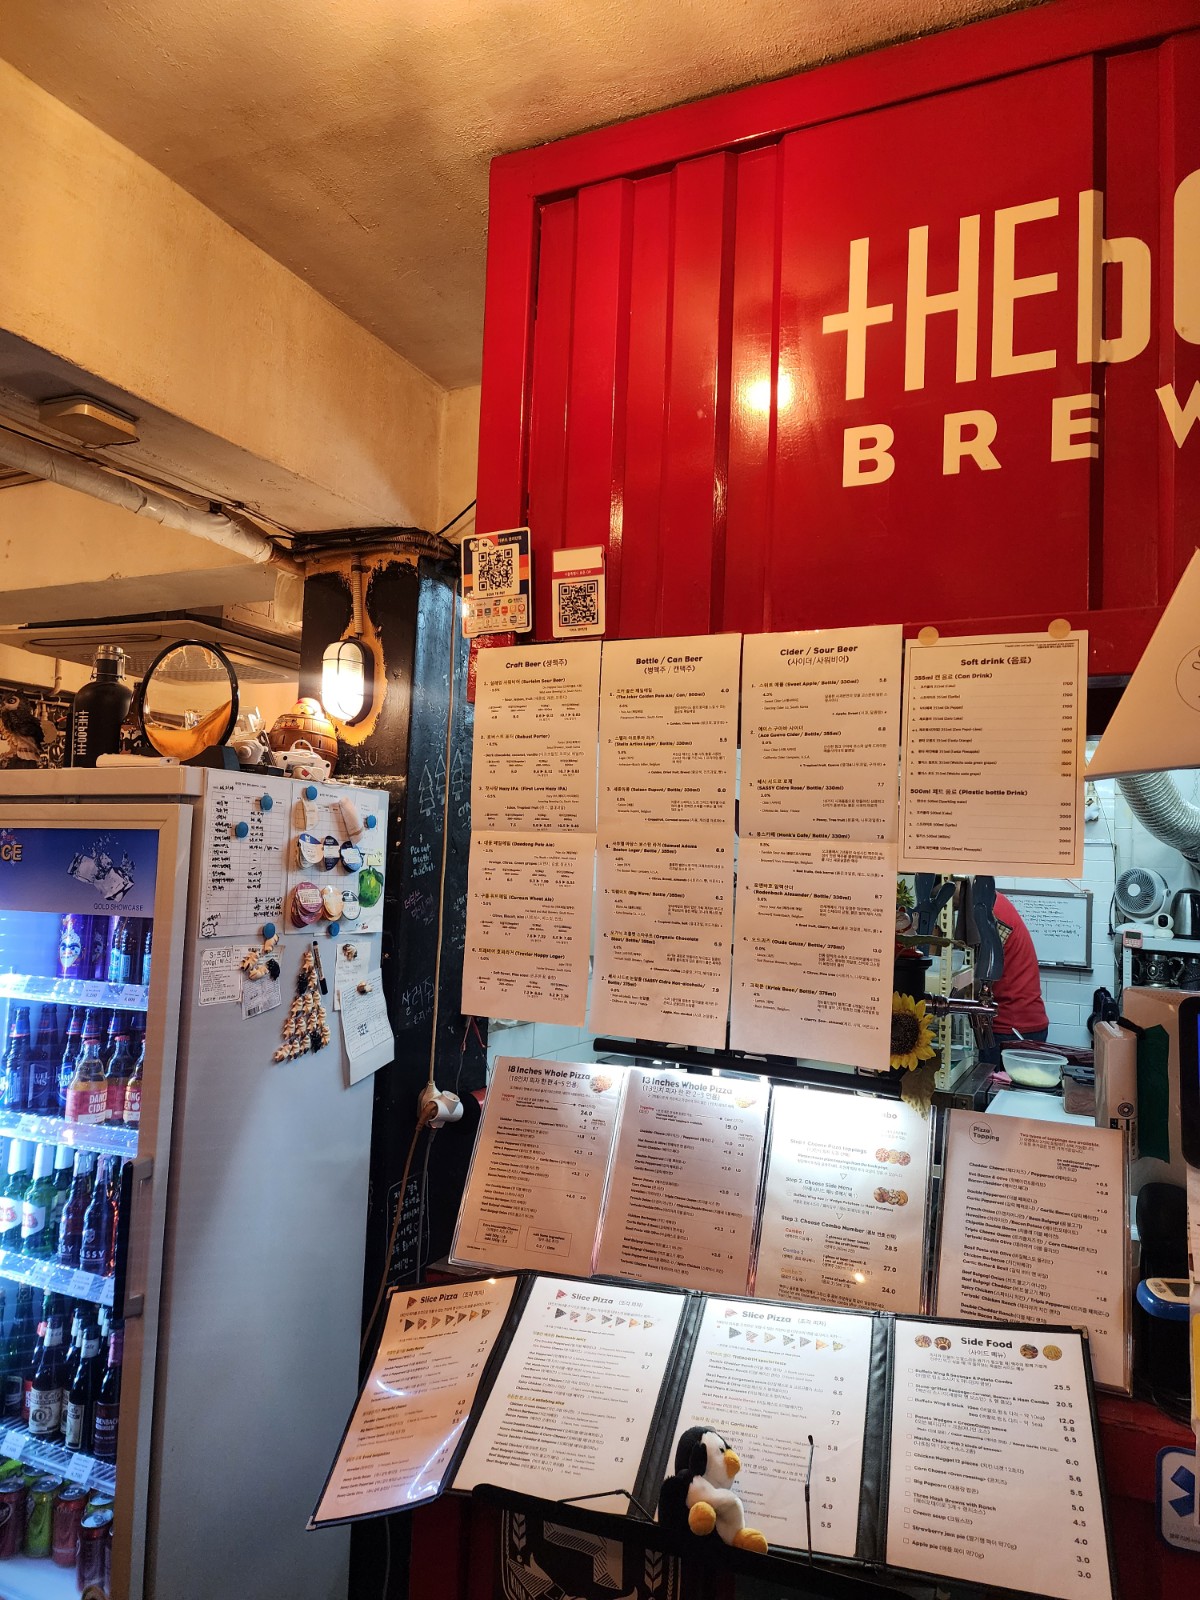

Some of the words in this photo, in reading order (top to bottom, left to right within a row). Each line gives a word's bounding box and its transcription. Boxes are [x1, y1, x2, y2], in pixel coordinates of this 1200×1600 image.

[780, 648, 804, 656] Cider
[981, 657, 1004, 665] drink
[516, 1066, 542, 1075] Inches
[544, 1069, 568, 1078] Whole
[570, 1072, 590, 1080] Pizza
[642, 1076, 651, 1084] 13
[652, 1078, 680, 1088] Inches
[681, 1080, 708, 1092] Whole
[710, 1084, 732, 1094] Pizza
[973, 1133, 1000, 1142] Topping
[800, 1219, 820, 1227] Choose
[822, 1222, 841, 1230] Combo
[884, 1244, 898, 1252] 28.5
[883, 1265, 896, 1273] 27.0
[882, 1287, 896, 1295] 24.0
[439, 1293, 458, 1301] Pizza
[571, 1293, 591, 1301] Slice
[743, 1311, 764, 1320] Slice
[766, 1314, 792, 1323] Pizza
[961, 1337, 984, 1346] Side
[986, 1340, 1013, 1349] Food
[1070, 1489, 1083, 1497] 5.5
[1071, 1504, 1085, 1512] 5.0
[1073, 1519, 1086, 1527] 4.5
[912, 1540, 928, 1548] Apple
[1074, 1537, 1088, 1546] 4.0
[1076, 1556, 1090, 1564] 3.0
[1078, 1571, 1091, 1579] 3.0
